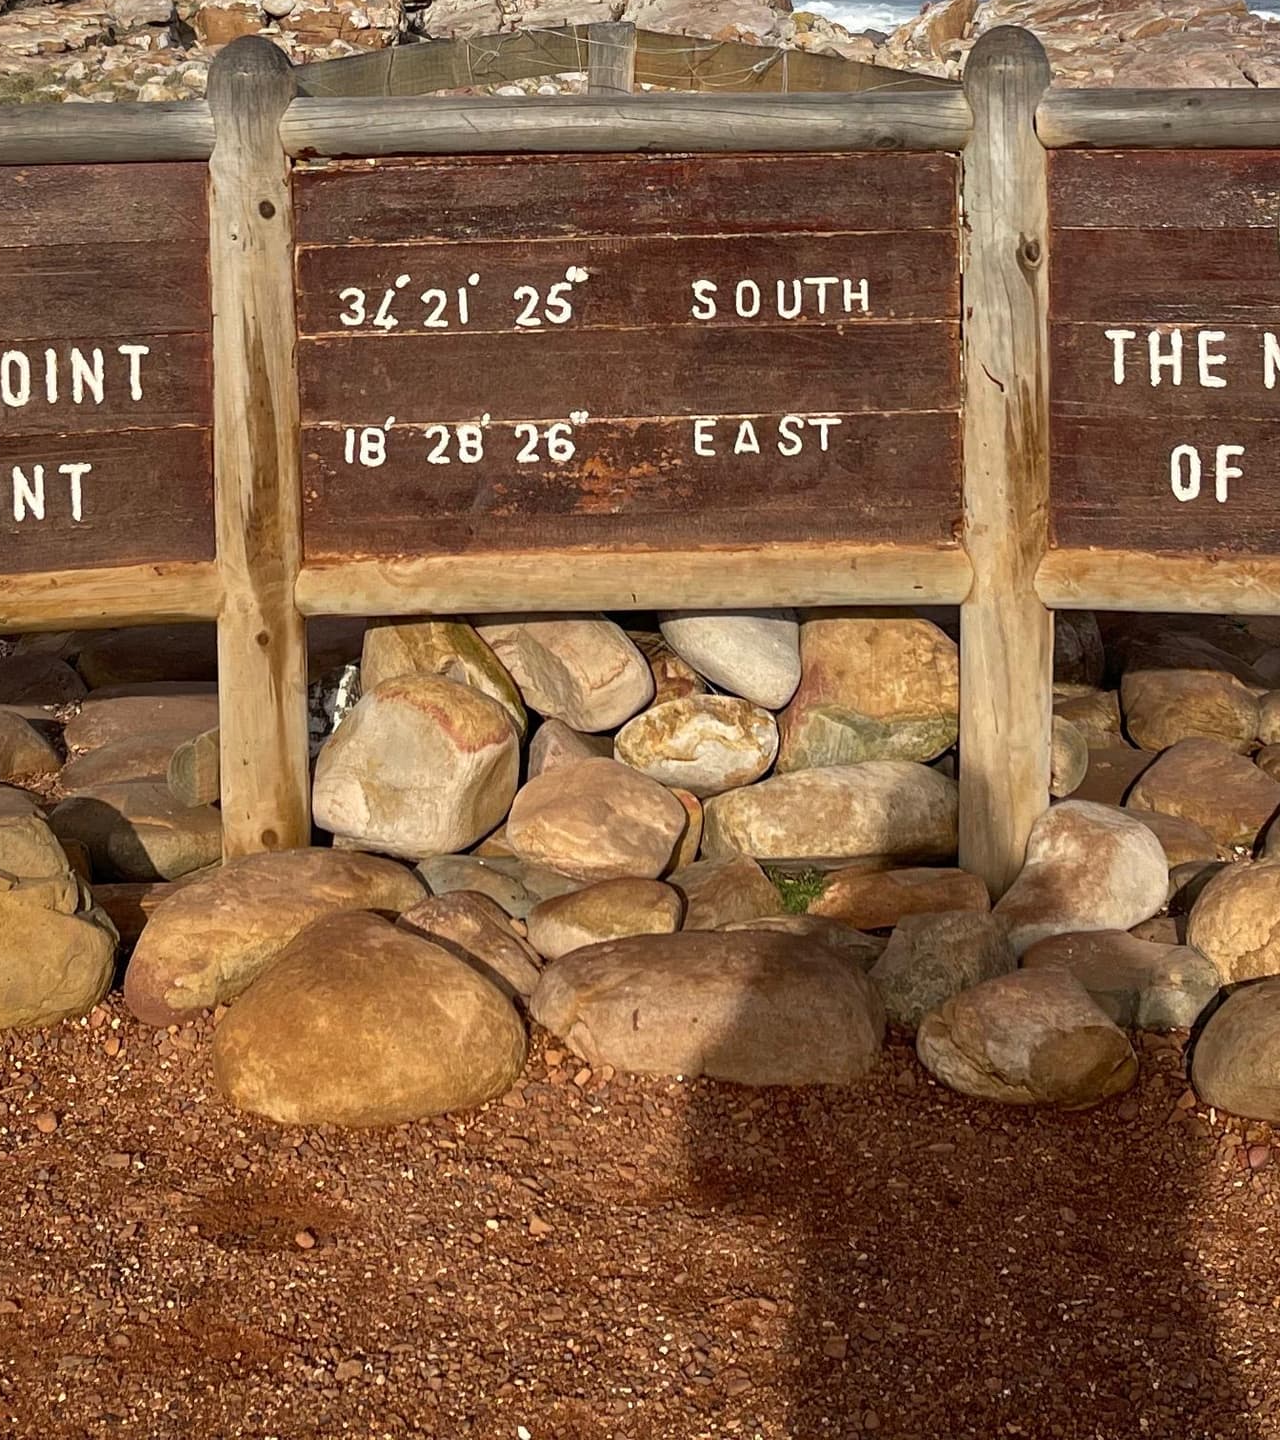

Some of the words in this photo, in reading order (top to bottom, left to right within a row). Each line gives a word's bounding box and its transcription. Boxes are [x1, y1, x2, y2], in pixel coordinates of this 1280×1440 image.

[690, 276, 870, 321] SOUTH
[1103, 327, 1228, 389] THE
[691, 414, 845, 457] EAST
[1169, 443, 1246, 504] OF
